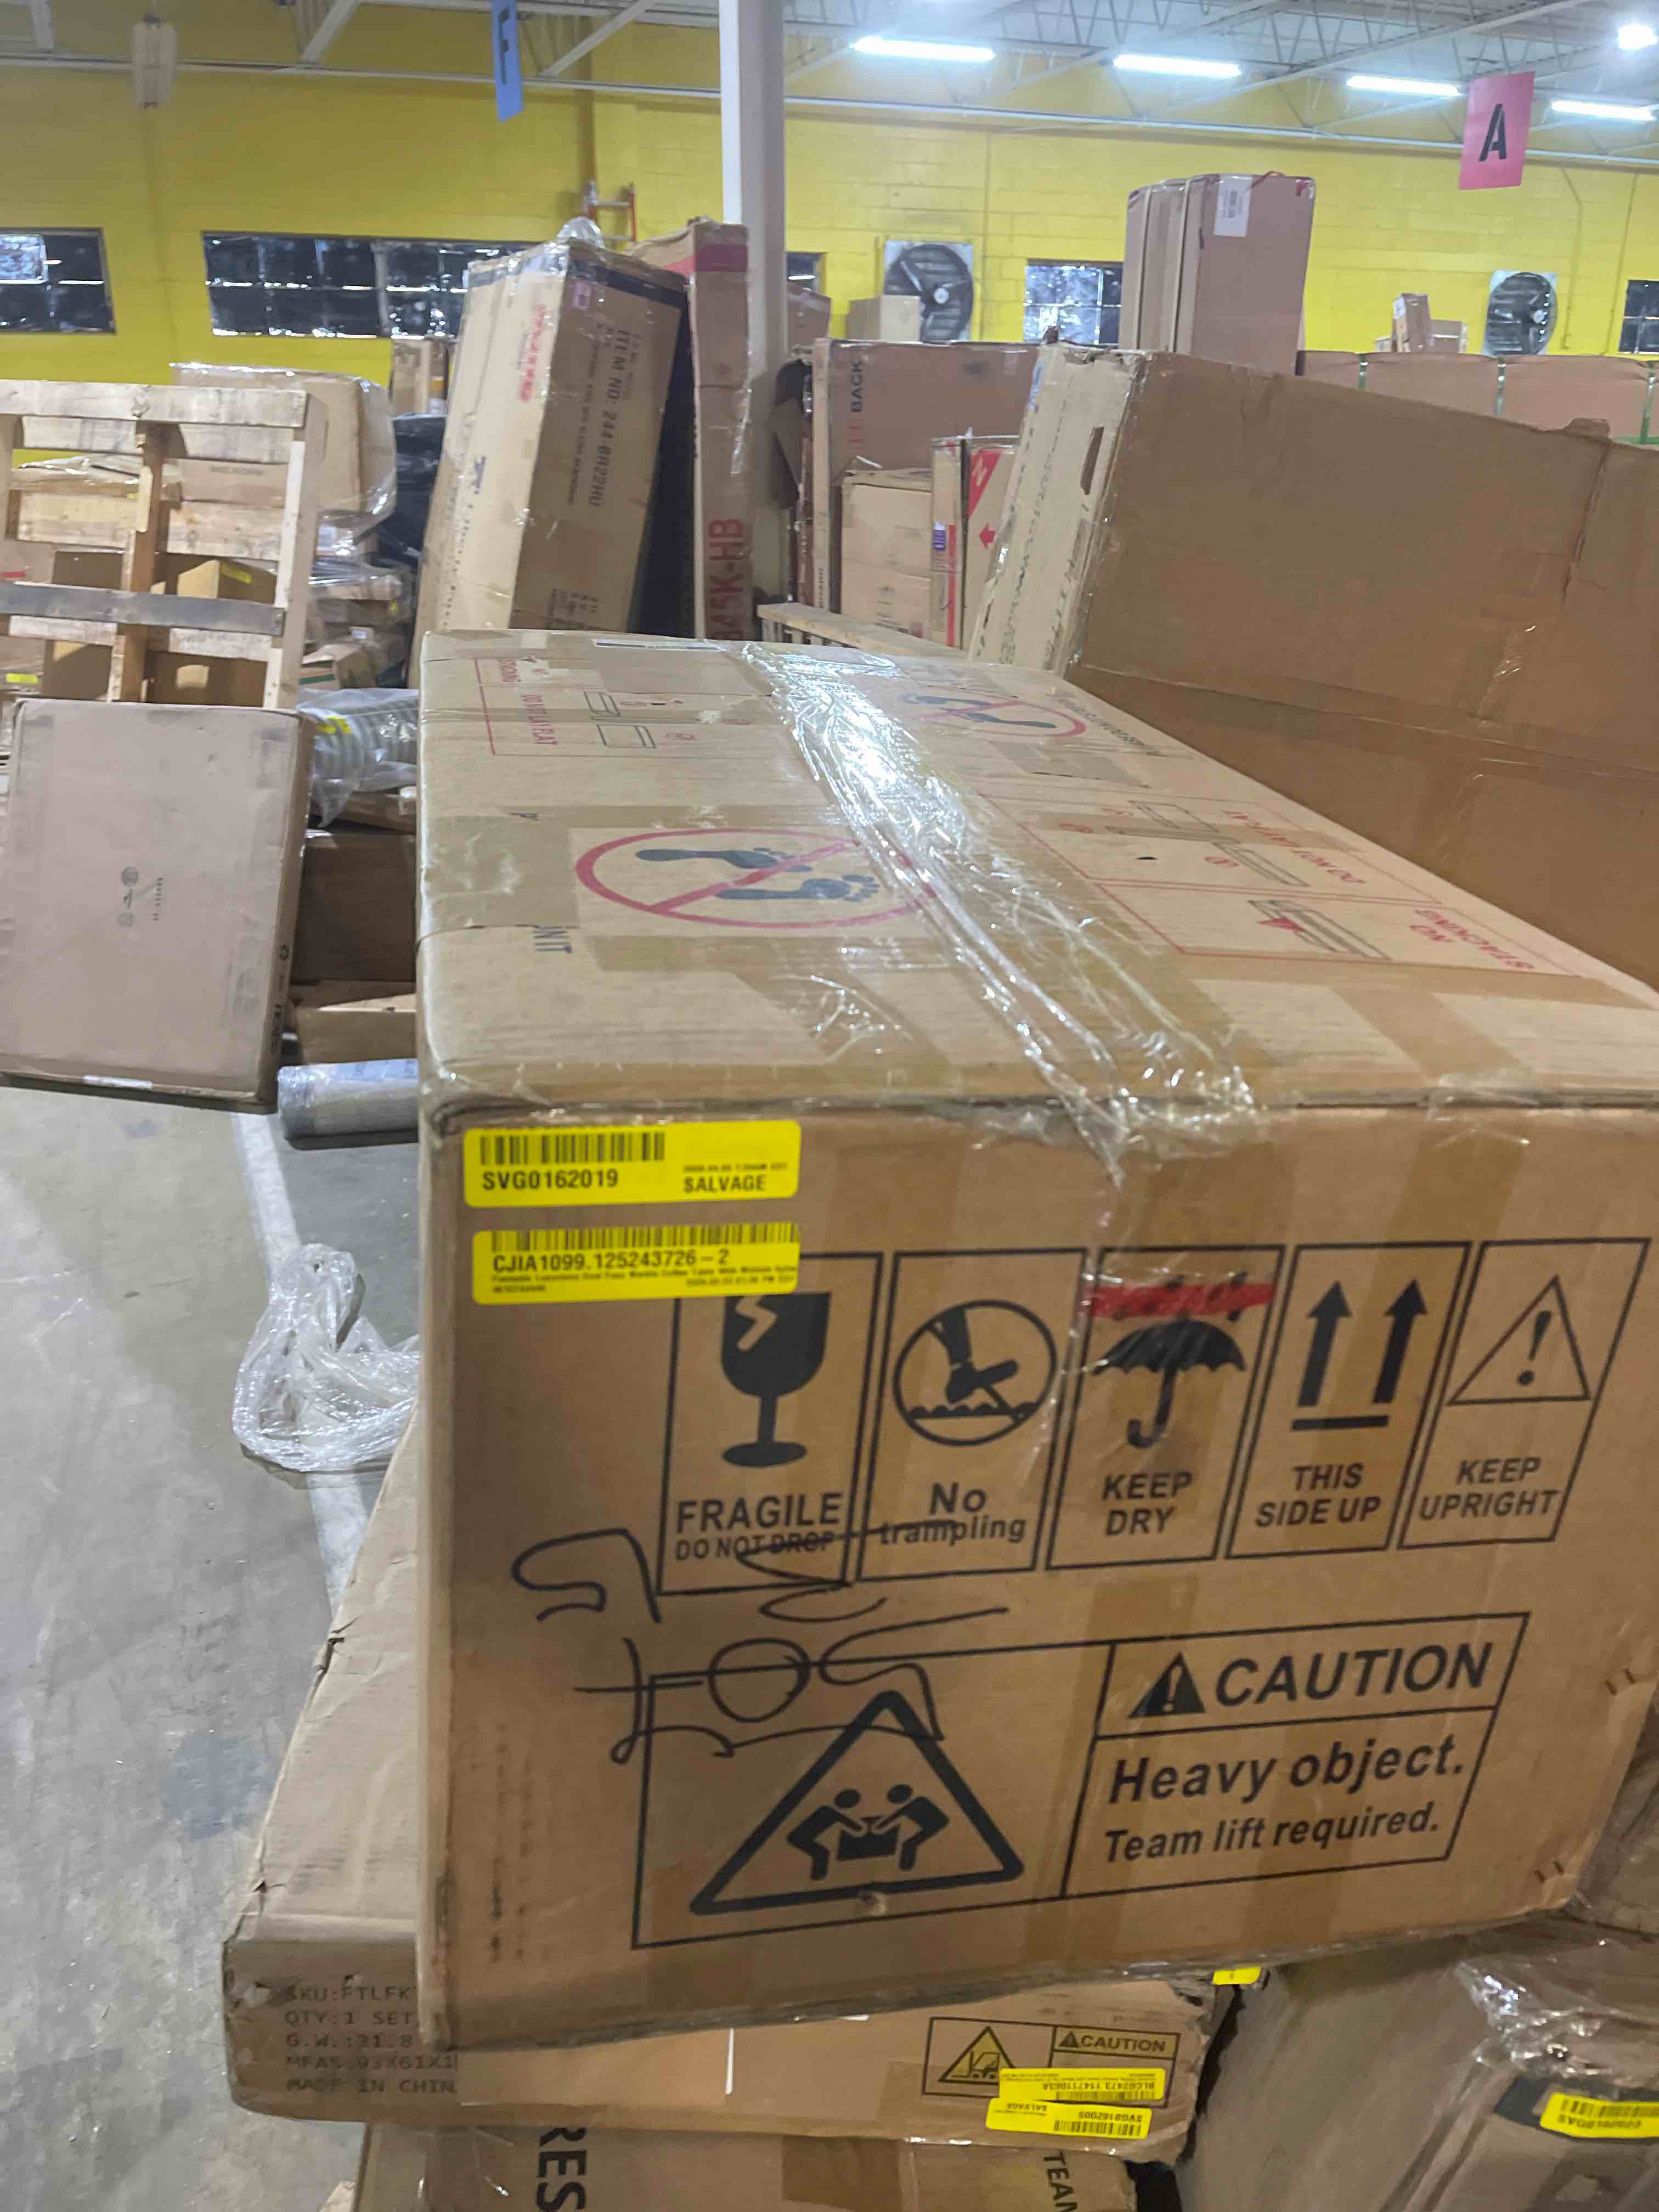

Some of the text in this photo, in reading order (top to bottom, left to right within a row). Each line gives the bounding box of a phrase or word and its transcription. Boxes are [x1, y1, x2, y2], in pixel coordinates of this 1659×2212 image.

[1479, 104, 1507, 161] A
[851, 360, 863, 413] BACK
[482, 1168, 766, 1193] SVG0162019 SALVAGE
[718, 1248, 730, 1265] 2
[1291, 1463, 1364, 1492] THIS
[1457, 1457, 1542, 1485] KEEP
[929, 1482, 986, 1515] No
[1102, 1471, 1193, 1501] KEEP
[675, 1493, 843, 1534] FRAGILE
[1255, 1496, 1381, 1528] SIDE UP
[1419, 1489, 1559, 1521] UPRIGHT
[880, 1516, 1026, 1545] trampling
[1105, 1507, 1174, 1537] DRY
[675, 1538, 709, 1560] DO
[717, 1534, 765, 1558] NOT
[1215, 1643, 1494, 1707] CAUTION
[1109, 1734, 1464, 1804] Heavy object.
[1105, 1801, 1438, 1863] Team lift required.
[288, 1985, 417, 2002] SKU:FTLFK
[285, 2011, 356, 2027] QTY:1
[1081, 2034, 1166, 2052] CAUTION
[358, 2079, 385, 2093] IN
[1005, 2102, 1048, 2112] SALVAGE
